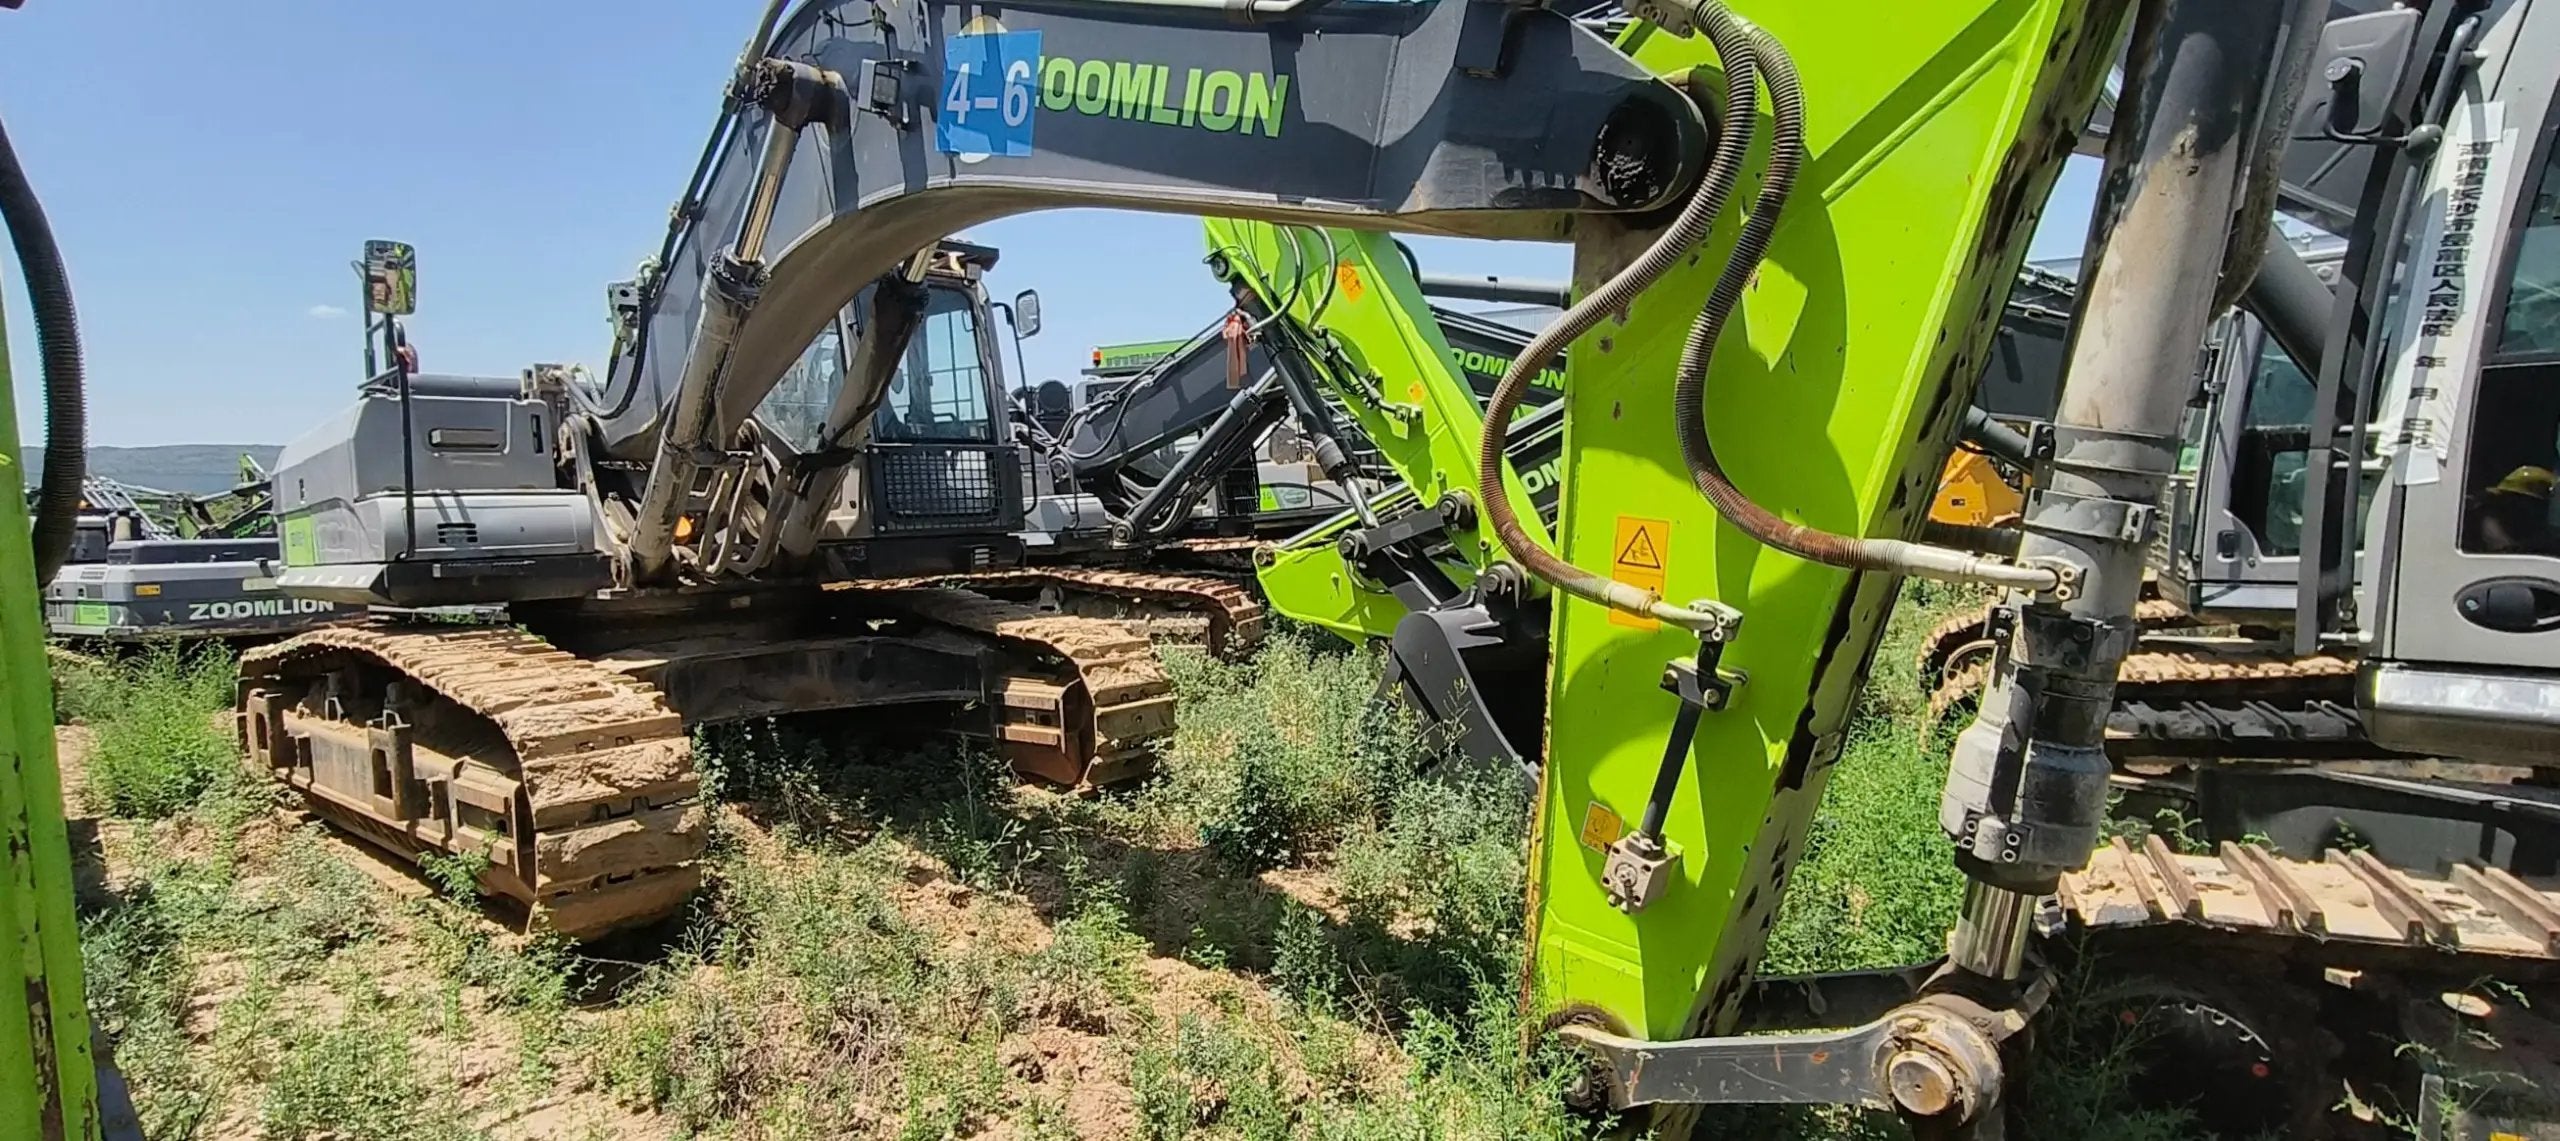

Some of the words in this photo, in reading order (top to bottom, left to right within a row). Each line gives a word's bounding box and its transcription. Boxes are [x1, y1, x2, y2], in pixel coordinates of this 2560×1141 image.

[946, 60, 1030, 127] 4-6
[1035, 55, 1289, 138] OOMLION
[2415, 356, 2447, 369] 年
[2409, 387, 2438, 400] 月
[188, 598, 334, 621] ZOOMLION
